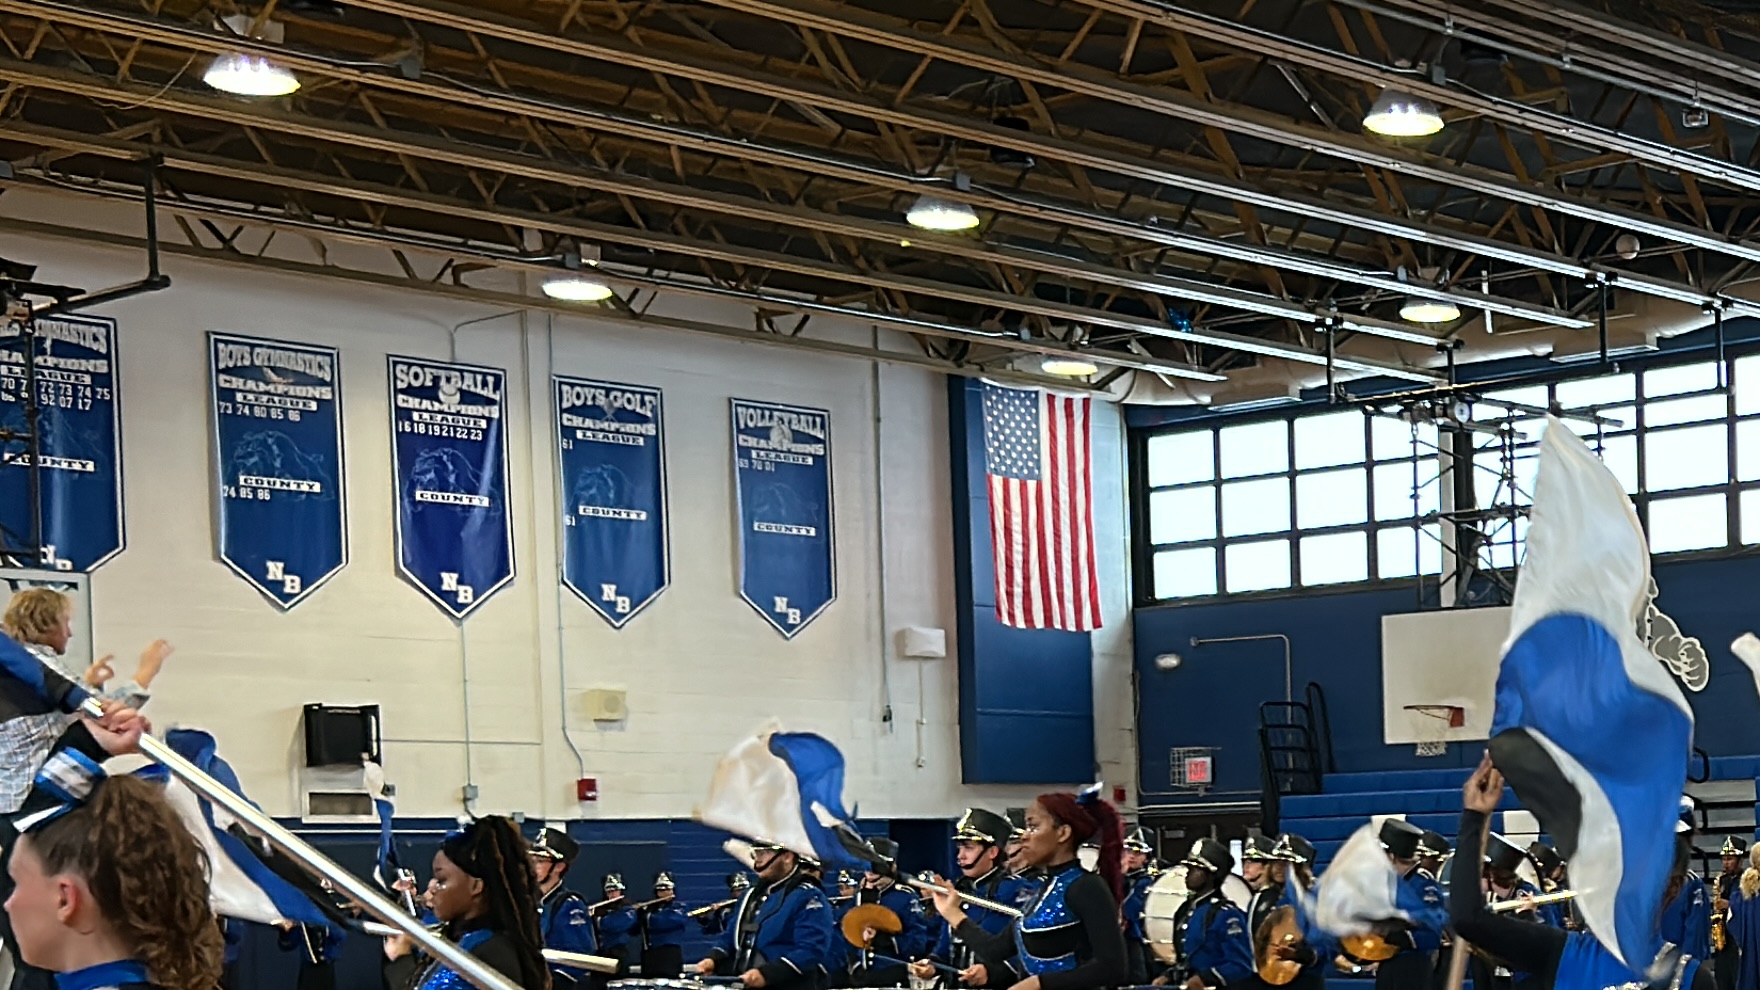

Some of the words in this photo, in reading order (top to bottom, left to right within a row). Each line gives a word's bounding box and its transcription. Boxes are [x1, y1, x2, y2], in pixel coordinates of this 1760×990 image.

[217, 342, 252, 370] BOYS
[253, 347, 332, 382] GYMNASTICS
[40, 381, 54, 394] 72
[59, 384, 72, 397] 73
[77, 386, 91, 399] 74
[95, 388, 110, 401] 75
[218, 373, 333, 400] CHAMPIONS
[395, 363, 500, 401] SOFTBALL
[40, 393, 55, 406] 92
[77, 399, 91, 411] 17
[219, 401, 233, 414] 73
[236, 403, 250, 416] 74
[241, 392, 313, 409] LEAGUE
[397, 393, 500, 419] CHAMPIONS
[561, 383, 606, 410] BOYS
[609, 390, 657, 418] GOLF
[413, 422, 426, 434] 18
[428, 424, 441, 436] 19
[442, 425, 454, 438] 21
[456, 427, 468, 440] 22
[470, 429, 483, 441] 23
[417, 413, 483, 429] LEAGUE
[562, 412, 657, 436] CHAMPIONS
[737, 405, 825, 440] VOLLEYBALL
[581, 431, 641, 445] LEAGUE
[738, 433, 825, 456] CHAMPIONS
[755, 452, 810, 465] LEAGUE
[242, 476, 317, 491] COUNTY
[419, 492, 486, 506] COUNTY
[582, 507, 643, 519] COUNTY
[757, 523, 812, 535] COUNTY
[266, 560, 302, 594] NB
[440, 572, 474, 604] NB
[601, 583, 631, 614] NB
[774, 596, 801, 624] NB
